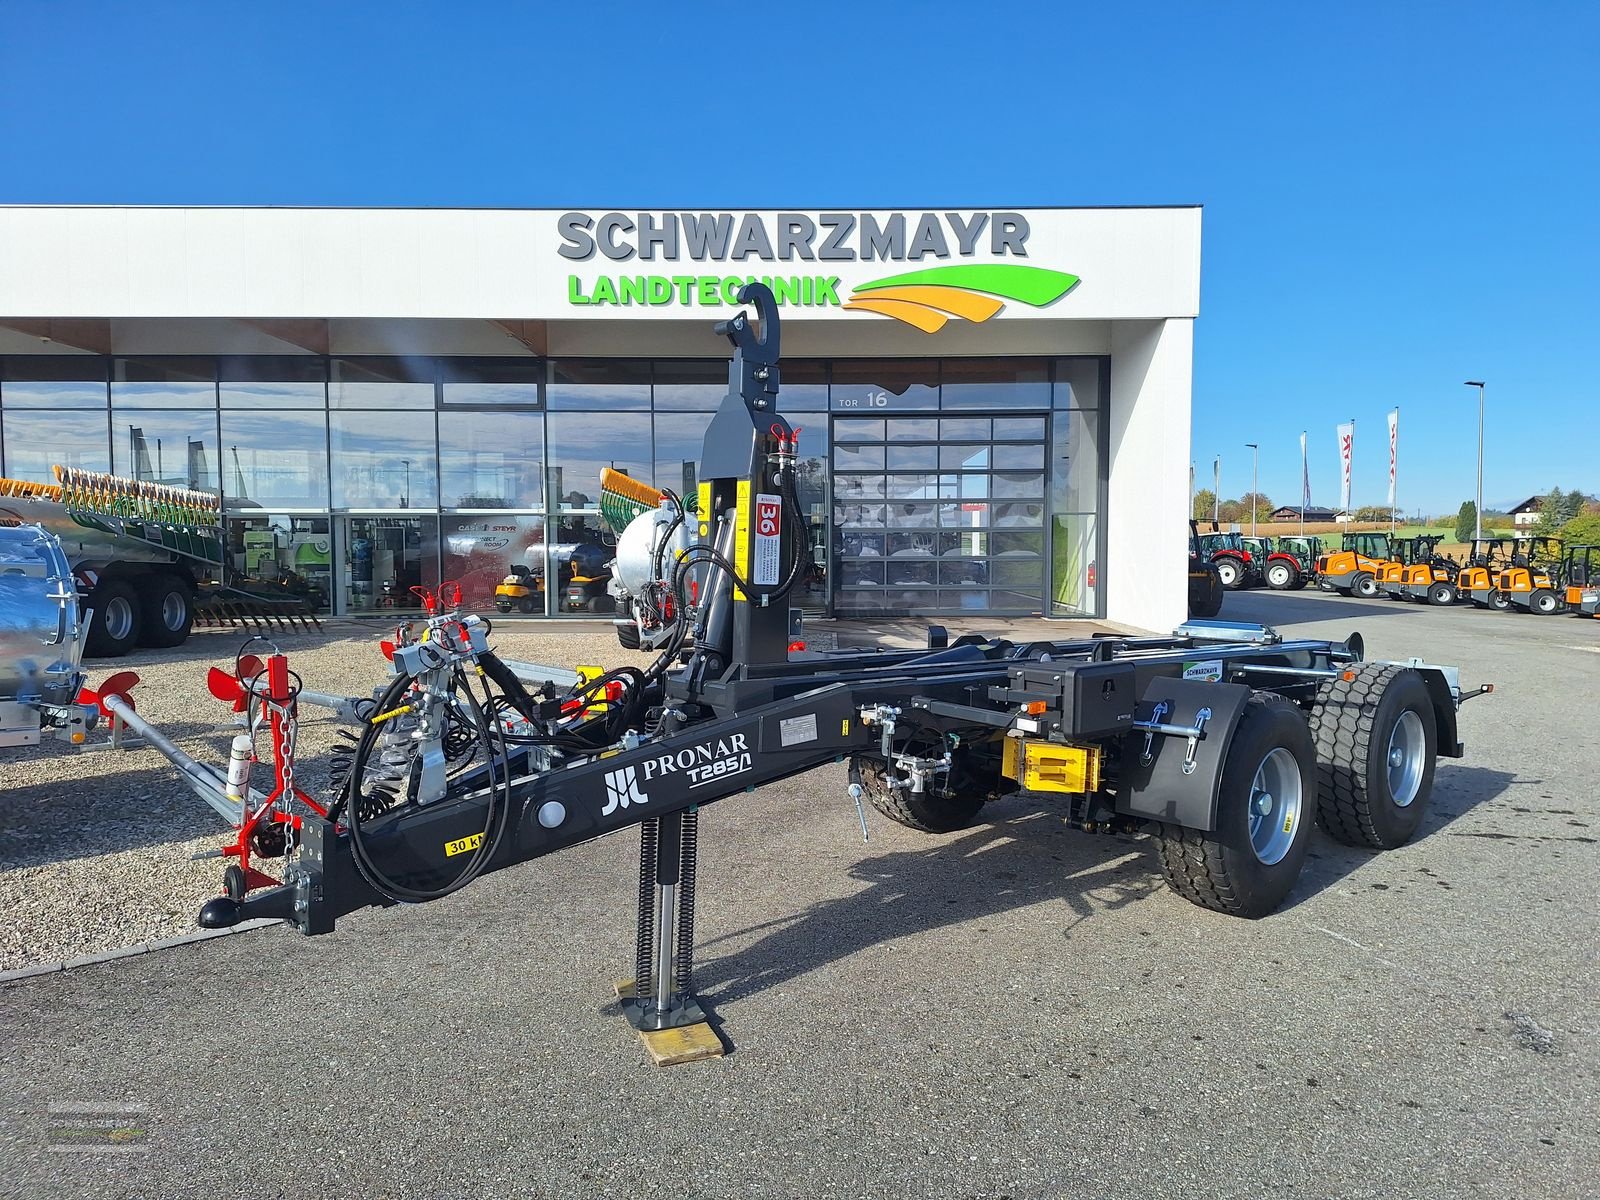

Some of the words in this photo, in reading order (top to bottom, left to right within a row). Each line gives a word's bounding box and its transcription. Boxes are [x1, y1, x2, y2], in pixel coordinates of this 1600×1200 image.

[556, 212, 1031, 261] SCHWARZMAYR
[839, 399, 858, 407] TOR
[867, 391, 888, 407] 16
[760, 505, 777, 533] 36
[641, 733, 749, 781] PRONAR
[686, 752, 752, 783] T285/1
[450, 840, 466, 853] 30
